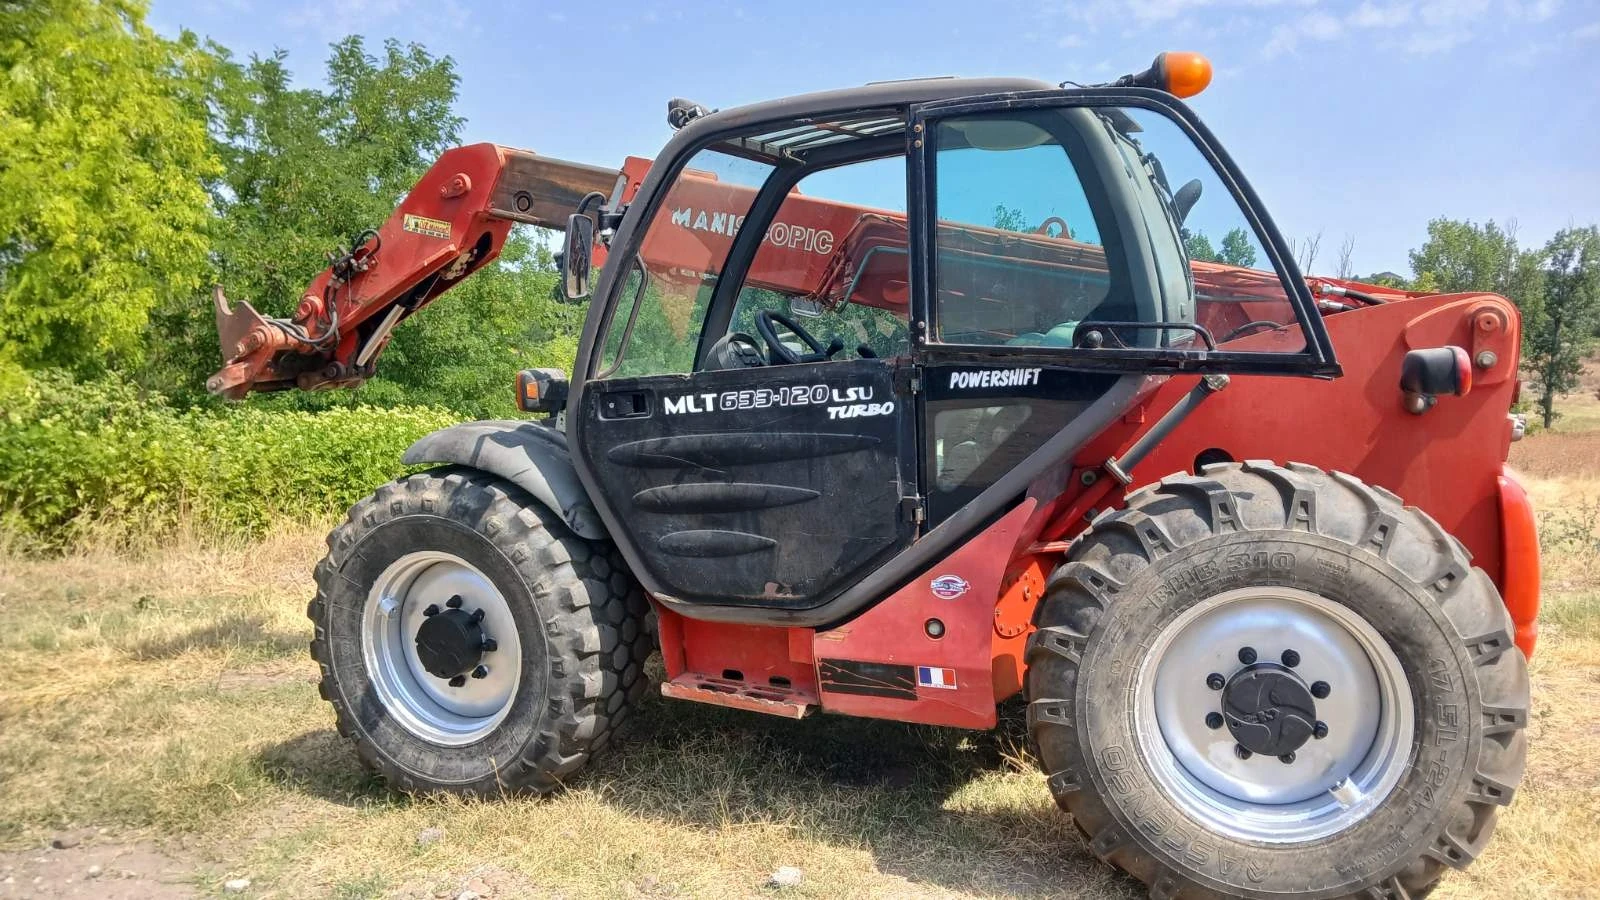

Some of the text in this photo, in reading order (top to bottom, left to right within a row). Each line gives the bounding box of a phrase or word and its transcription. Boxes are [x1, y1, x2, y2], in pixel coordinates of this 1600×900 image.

[949, 367, 1042, 389] POWERSHIFT
[664, 393, 717, 415] MLT
[832, 386, 873, 402] LSU
[826, 401, 894, 420] TURBO
[1226, 551, 1296, 573] 310
[1101, 745, 1244, 876] ASCENSO
